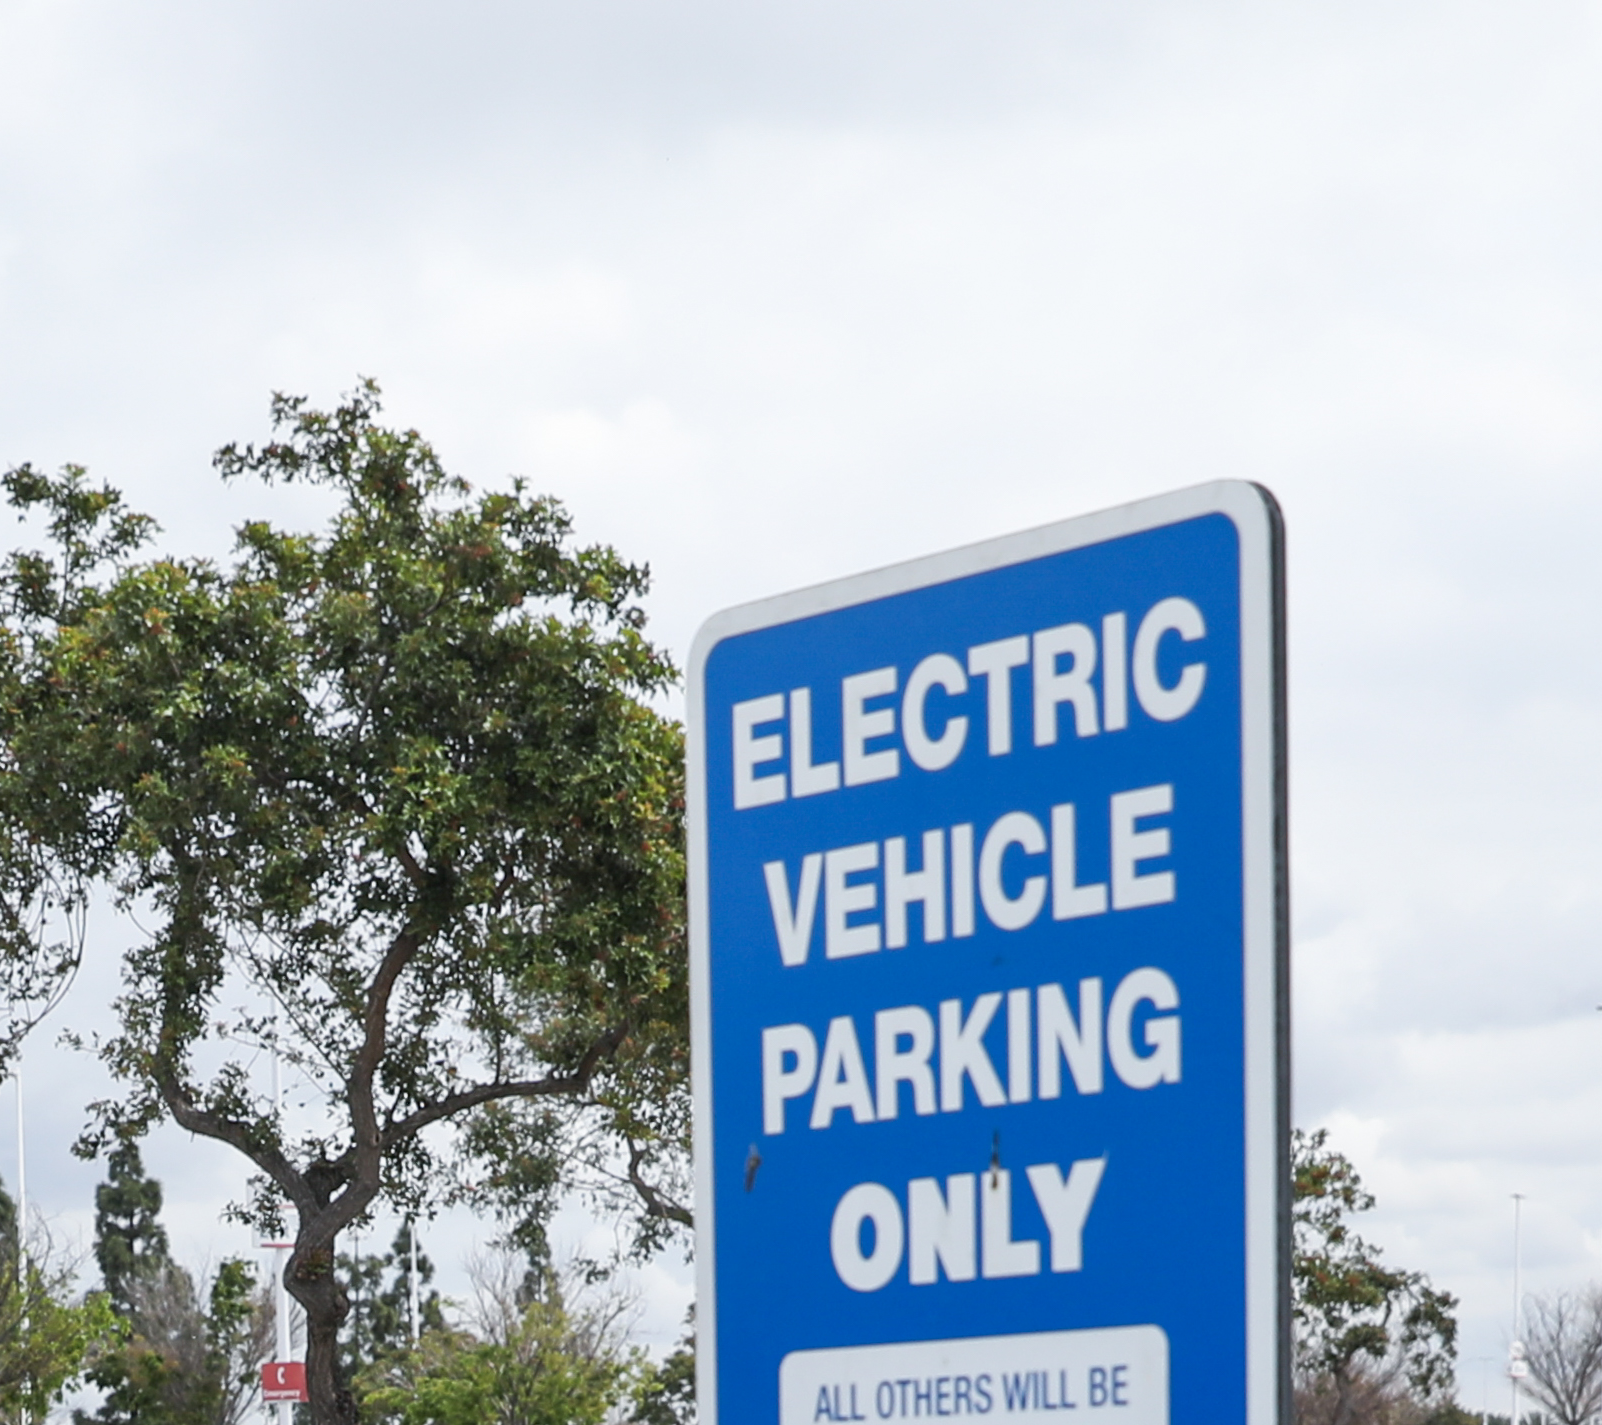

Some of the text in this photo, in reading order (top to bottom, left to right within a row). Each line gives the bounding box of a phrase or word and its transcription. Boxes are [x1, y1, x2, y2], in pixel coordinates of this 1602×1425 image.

[731, 596, 1207, 812] ELECTRIC
[763, 783, 1177, 967] VEHICLE
[762, 967, 1182, 1136] PARKING
[830, 1157, 1107, 1292] ONLY
[813, 1364, 1129, 1423] ALL OTHERS WILL BE
